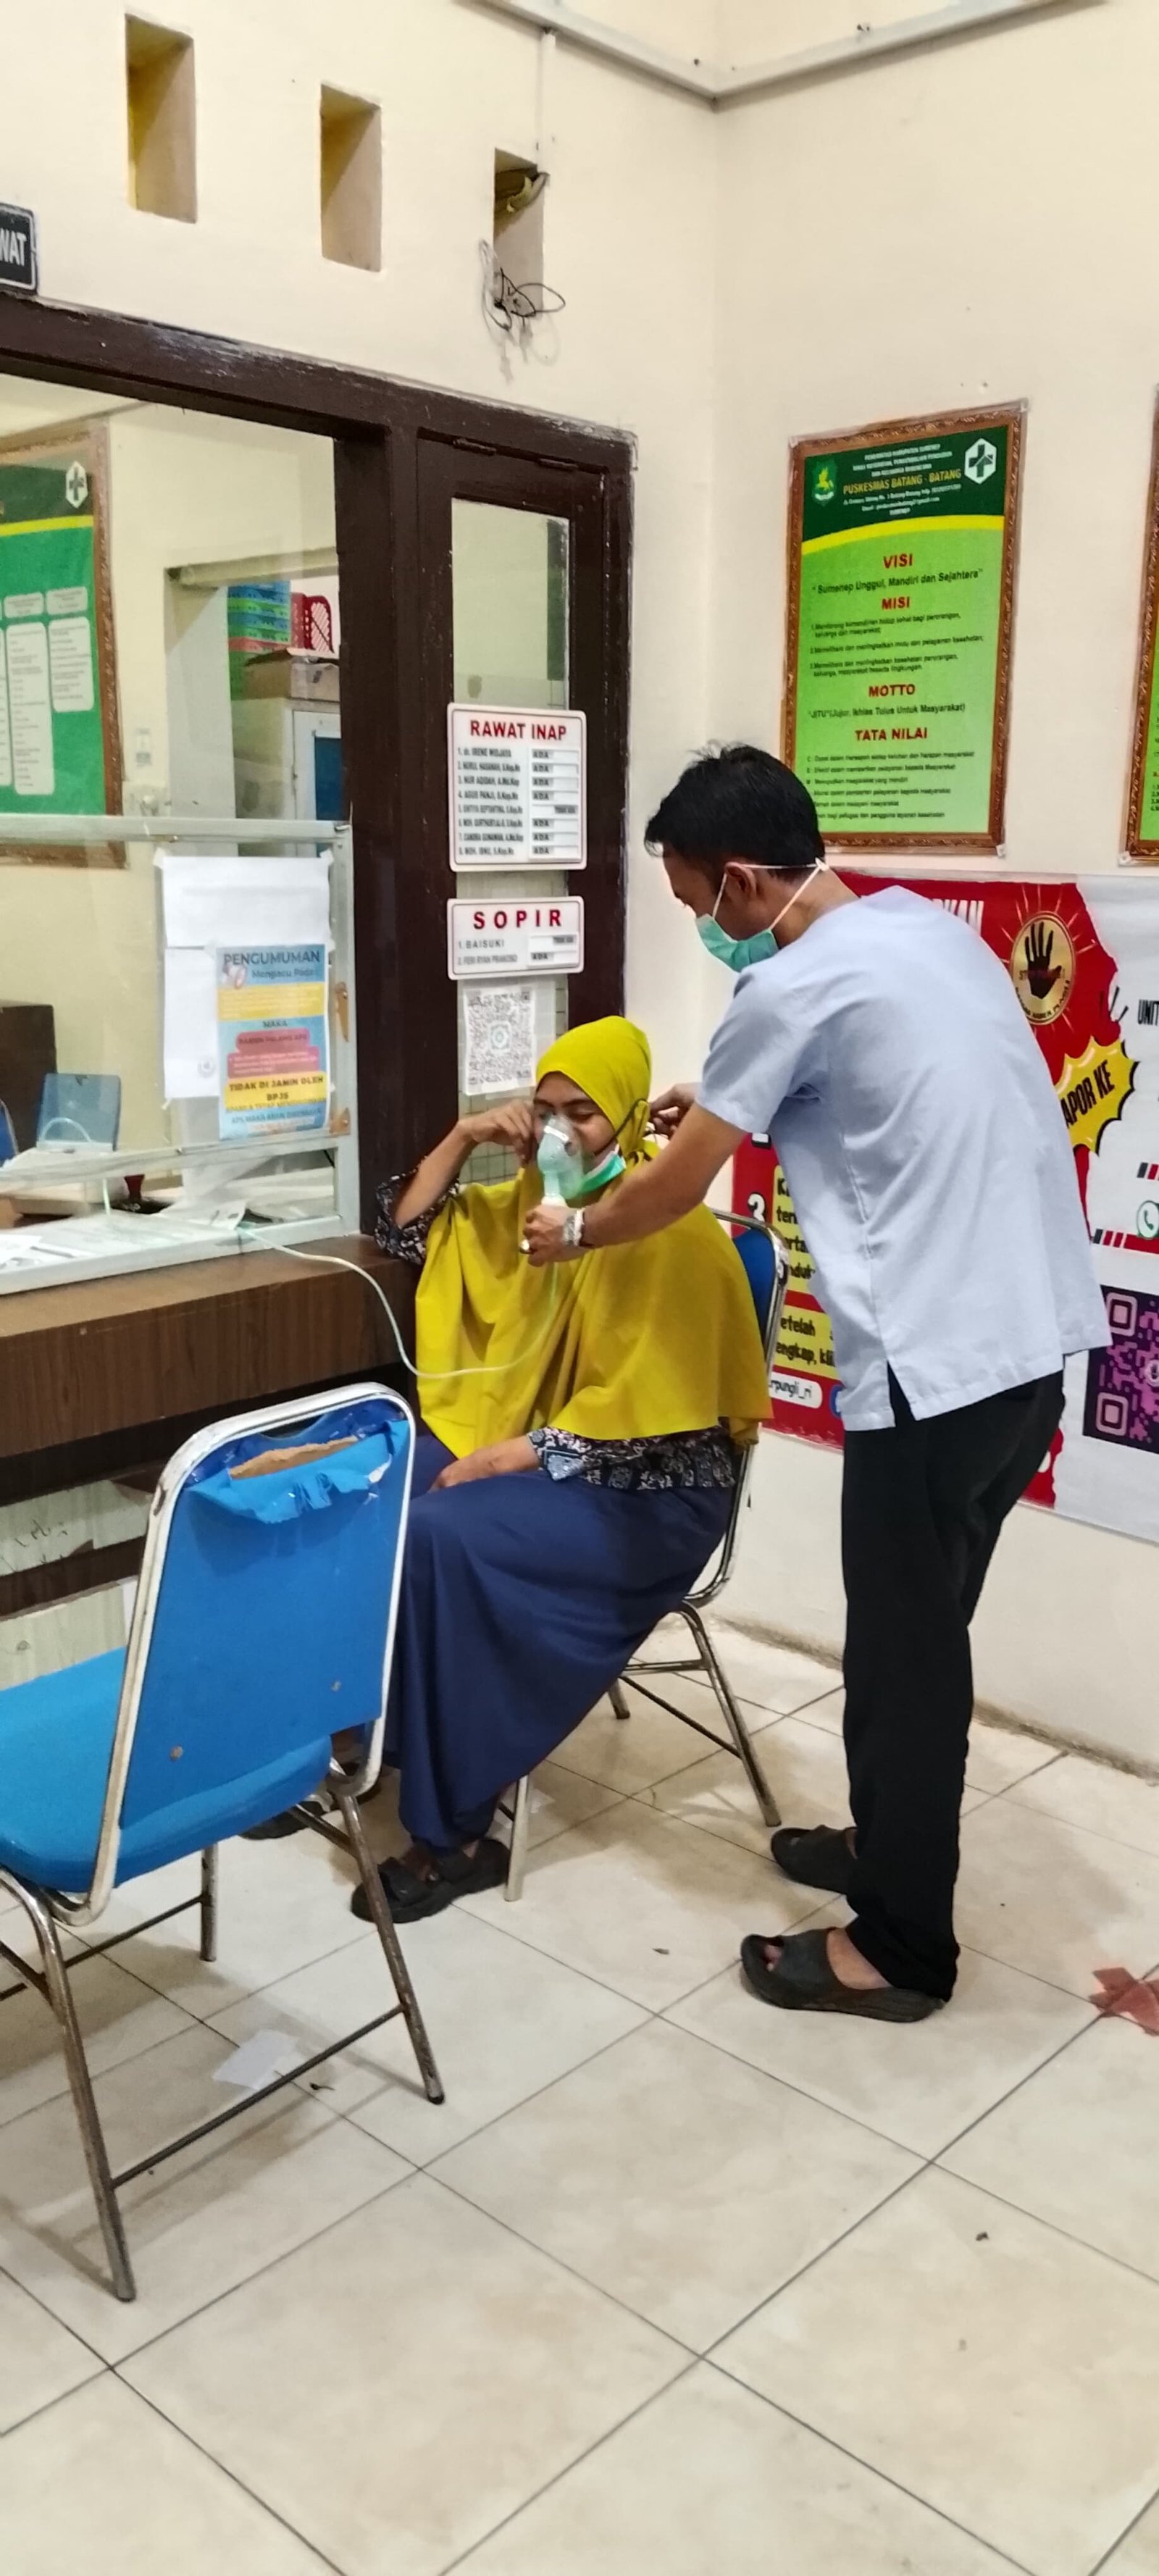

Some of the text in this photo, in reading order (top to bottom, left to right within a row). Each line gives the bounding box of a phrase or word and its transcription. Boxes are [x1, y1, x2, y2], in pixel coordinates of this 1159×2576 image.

[843, 480, 890, 494] PUSKESMAS
[891, 474, 923, 488] BATANG
[929, 469, 961, 482] BATANG
[883, 553, 913, 569] VISI
[888, 575, 919, 587] Mandiri
[882, 596, 911, 610] MISI
[869, 683, 916, 697] MOTTO
[470, 719, 566, 740] RAWAT INAP
[855, 727, 928, 741] TATA NILAI
[473, 909, 561, 929] SOPIR
[223, 950, 320, 965] PENGUMUMAN
[272, 1079, 298, 1087] JAMIN
[267, 1092, 289, 1101] BPJS
[1060, 1059, 1116, 1129] APOR KE
[748, 1194, 766, 1221] 3
[780, 1316, 816, 1337] etelah
[776, 1342, 817, 1366] engkap,
